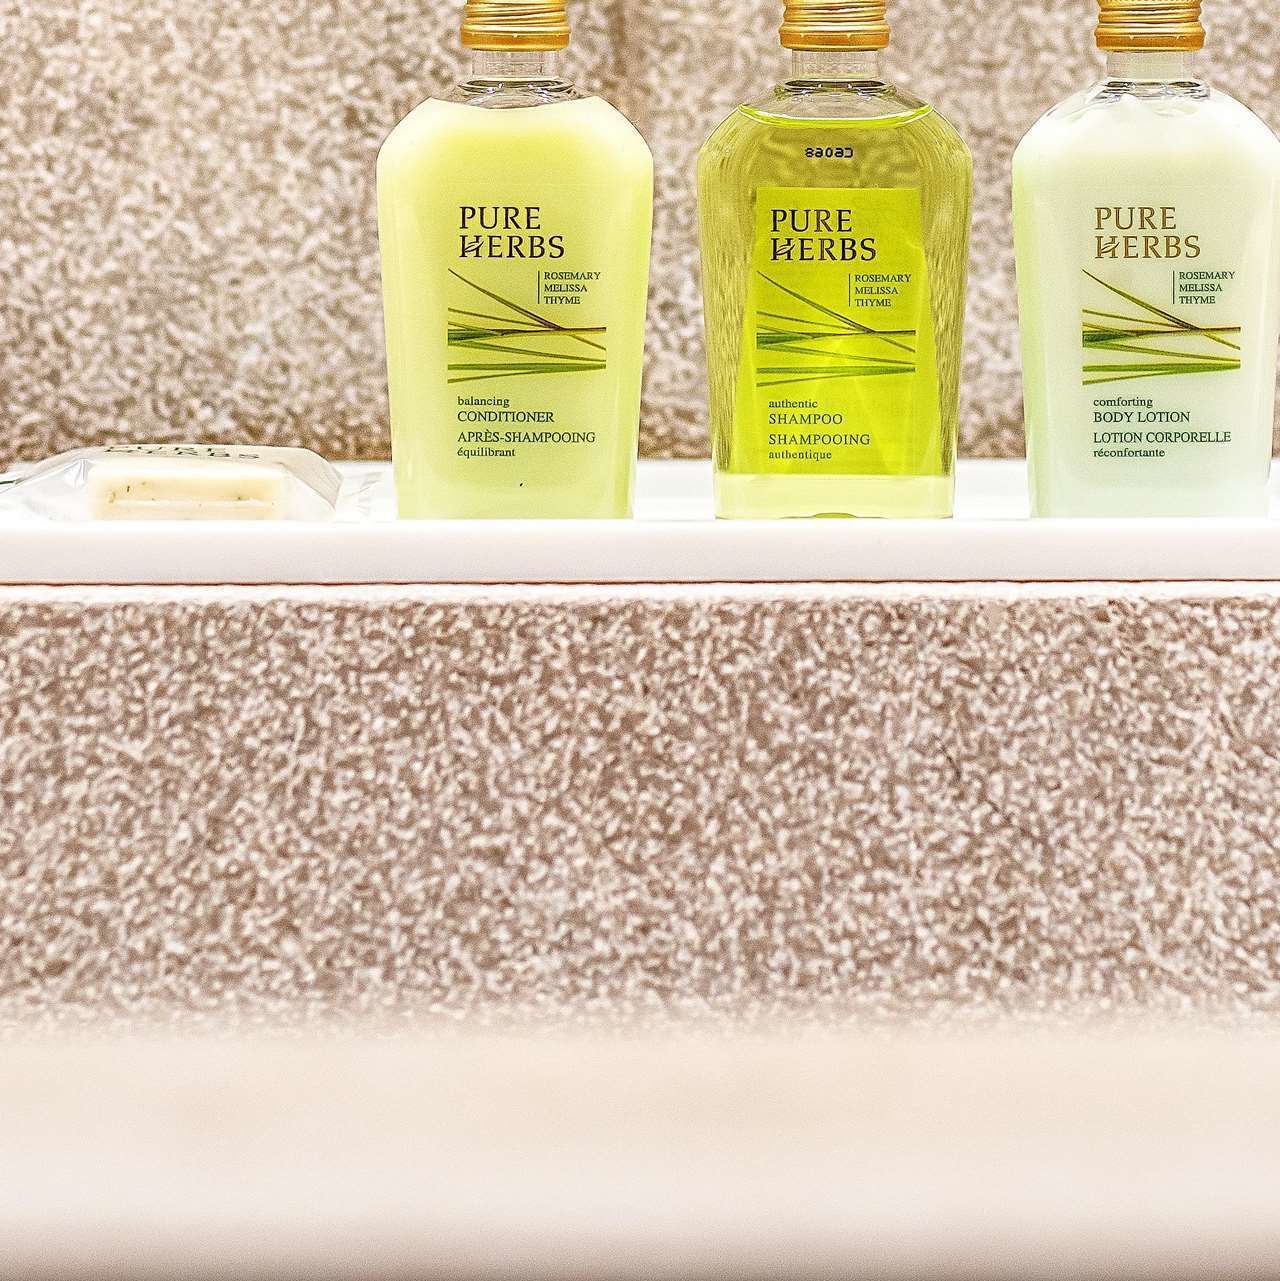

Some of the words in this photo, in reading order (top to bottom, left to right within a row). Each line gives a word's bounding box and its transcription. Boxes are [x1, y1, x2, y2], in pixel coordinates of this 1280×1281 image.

[459, 206, 541, 230] PURE
[770, 208, 852, 233] PURE
[1094, 206, 1177, 231] PURE
[458, 234, 565, 259] HERBS
[770, 237, 877, 262] HERBS
[1094, 234, 1201, 259] HERBS
[543, 271, 601, 281] ROSEMARY
[854, 273, 912, 283] ROSEMARY
[1178, 271, 1236, 280] ROSEMARY
[544, 283, 588, 293] MELISSA
[854, 286, 899, 295] MELISSA
[1179, 283, 1223, 293] MELISSA
[543, 295, 581, 305] THYME
[854, 298, 892, 307] THYME
[1178, 295, 1216, 305] THYME
[457, 395, 510, 409] balancing
[768, 398, 818, 409] authentic
[1093, 396, 1153, 409] comforting
[457, 410, 555, 423] CONDITIONER
[768, 413, 843, 425] SHAMPOO
[1093, 411, 1135, 423] BODY
[1137, 411, 1191, 424] LOTION
[457, 428, 596, 444] APRÈS-SHAMPOOING
[768, 433, 871, 446] SHAMPOOING
[1093, 431, 1143, 444] LOTION
[1145, 431, 1232, 444] CORPORELLE
[456, 446, 516, 459] équilibrant
[768, 449, 832, 462] authentique
[1093, 447, 1166, 458] réconfortante
